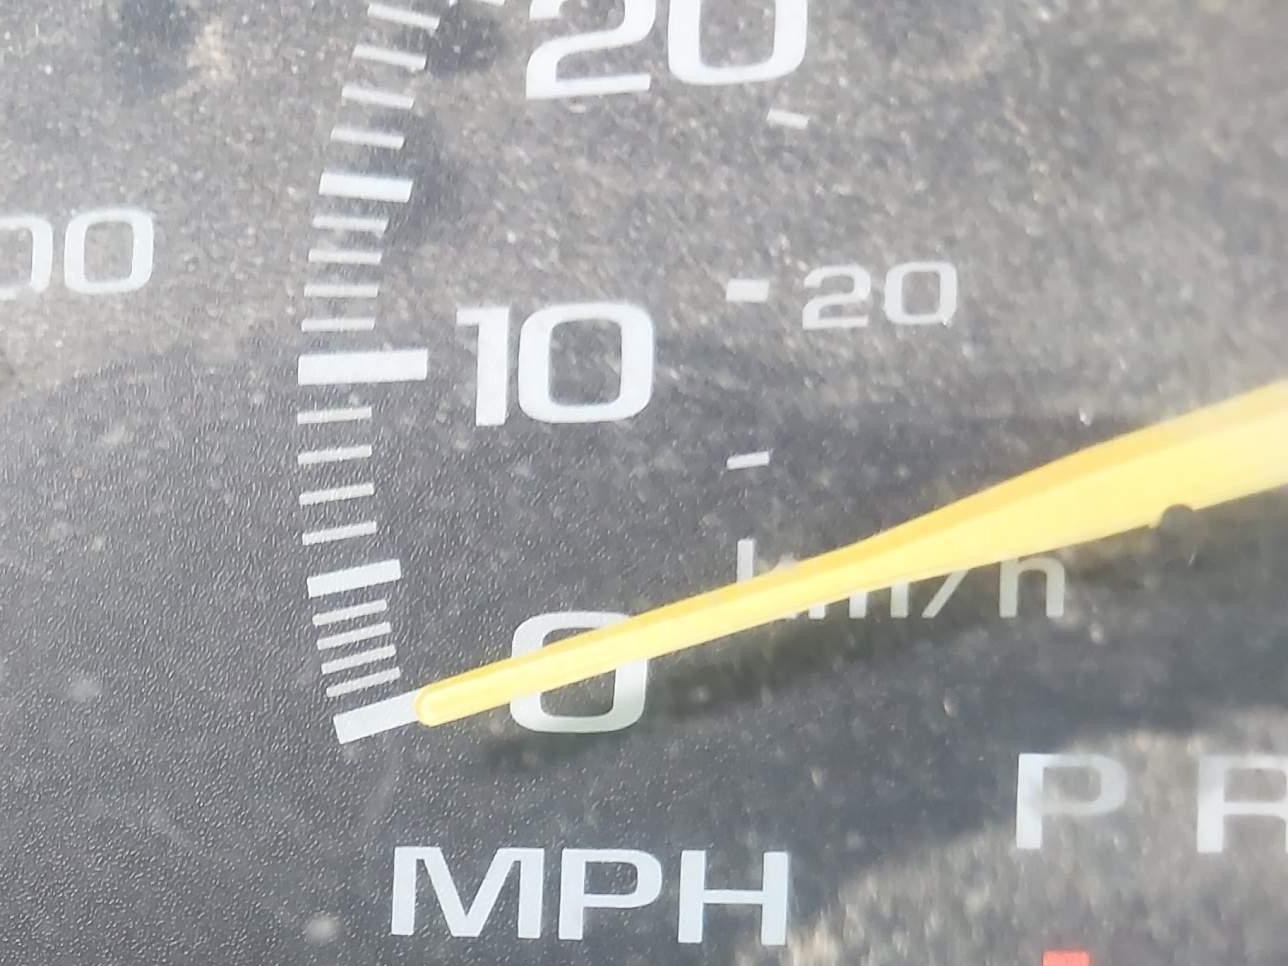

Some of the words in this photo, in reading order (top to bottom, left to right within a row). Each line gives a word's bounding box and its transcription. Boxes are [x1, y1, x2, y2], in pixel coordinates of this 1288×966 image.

[526, 0, 808, 99] 20
[802, 261, 958, 330] 20
[456, 302, 655, 427] 10
[510, 611, 647, 733] 0
[1016, 753, 1128, 849] P
[391, 846, 790, 946] MPH
